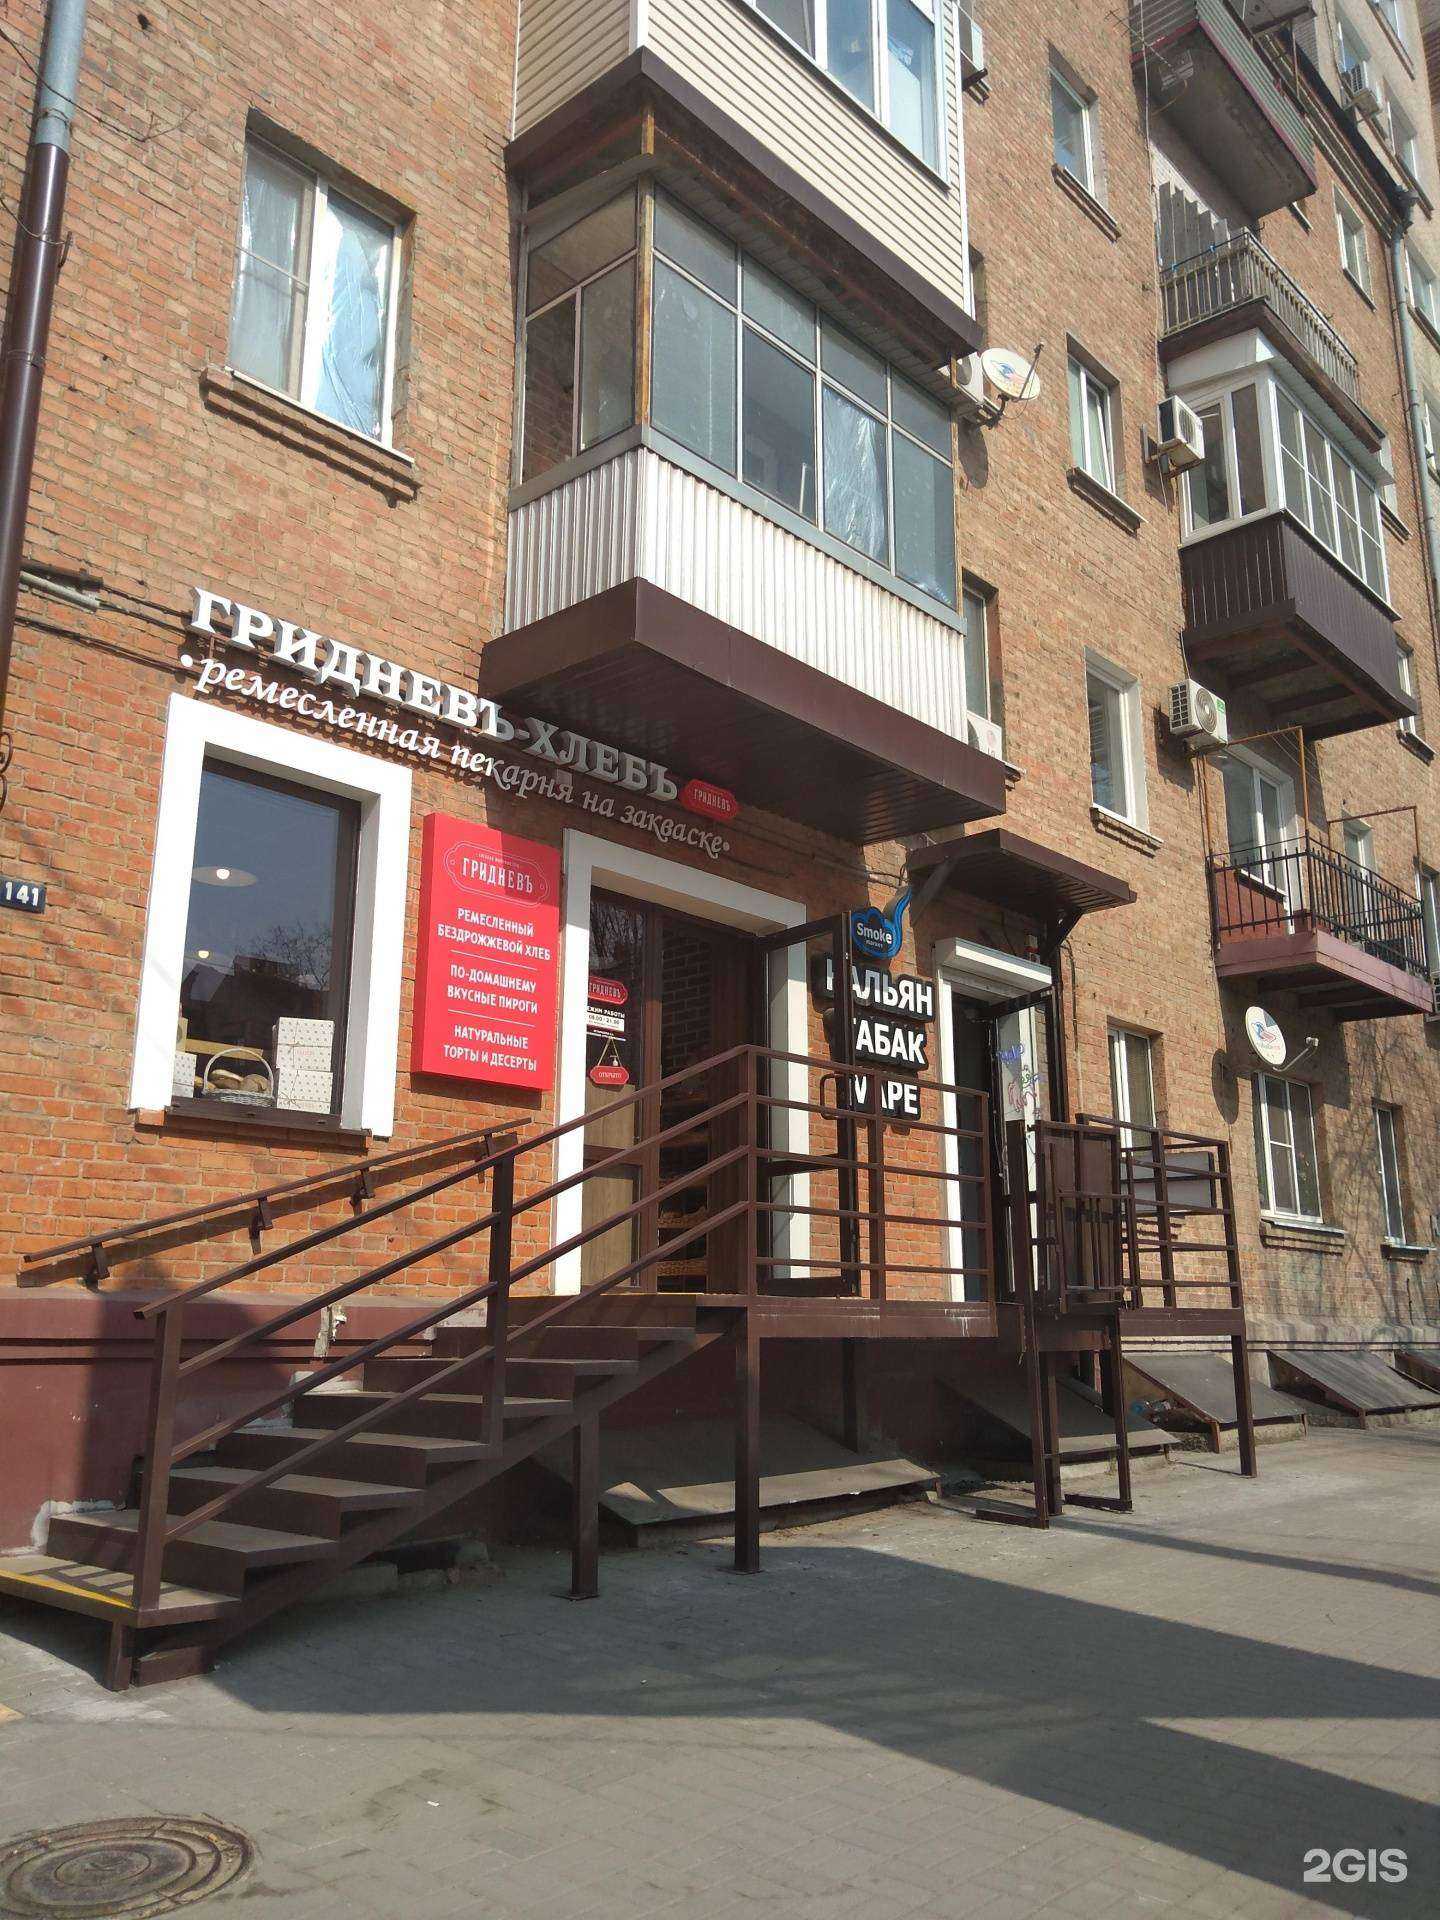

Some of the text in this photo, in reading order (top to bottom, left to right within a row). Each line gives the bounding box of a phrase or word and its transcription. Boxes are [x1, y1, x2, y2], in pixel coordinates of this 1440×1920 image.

[189, 586, 678, 801] ГРИДНЕВЪ-ХЛЕБЪ
[192, 657, 725, 860] ремесленная пекарня на закваске
[461, 857, 533, 894] ГРИДНЕВЪ
[5, 881, 39, 906] 141
[456, 907, 535, 938] РЕМЕСЛЕННЫЙ
[856, 922, 892, 944] Smoke
[437, 923, 551, 961] БЕЗДРОЖЖЕВОЙ ХЛЕБ
[450, 964, 537, 993] ПО-ДОМАШНЕМУ
[447, 984, 538, 1015] ВКУСНЫЕ ПИРОГИ
[454, 1023, 529, 1049] НАТУРАЛЬНЫЕ
[853, 1017, 926, 1065] АБАК
[443, 1043, 537, 1073] ТОРТЫ И ДЕСЕРТЫ
[854, 1074, 918, 1115] VPE
